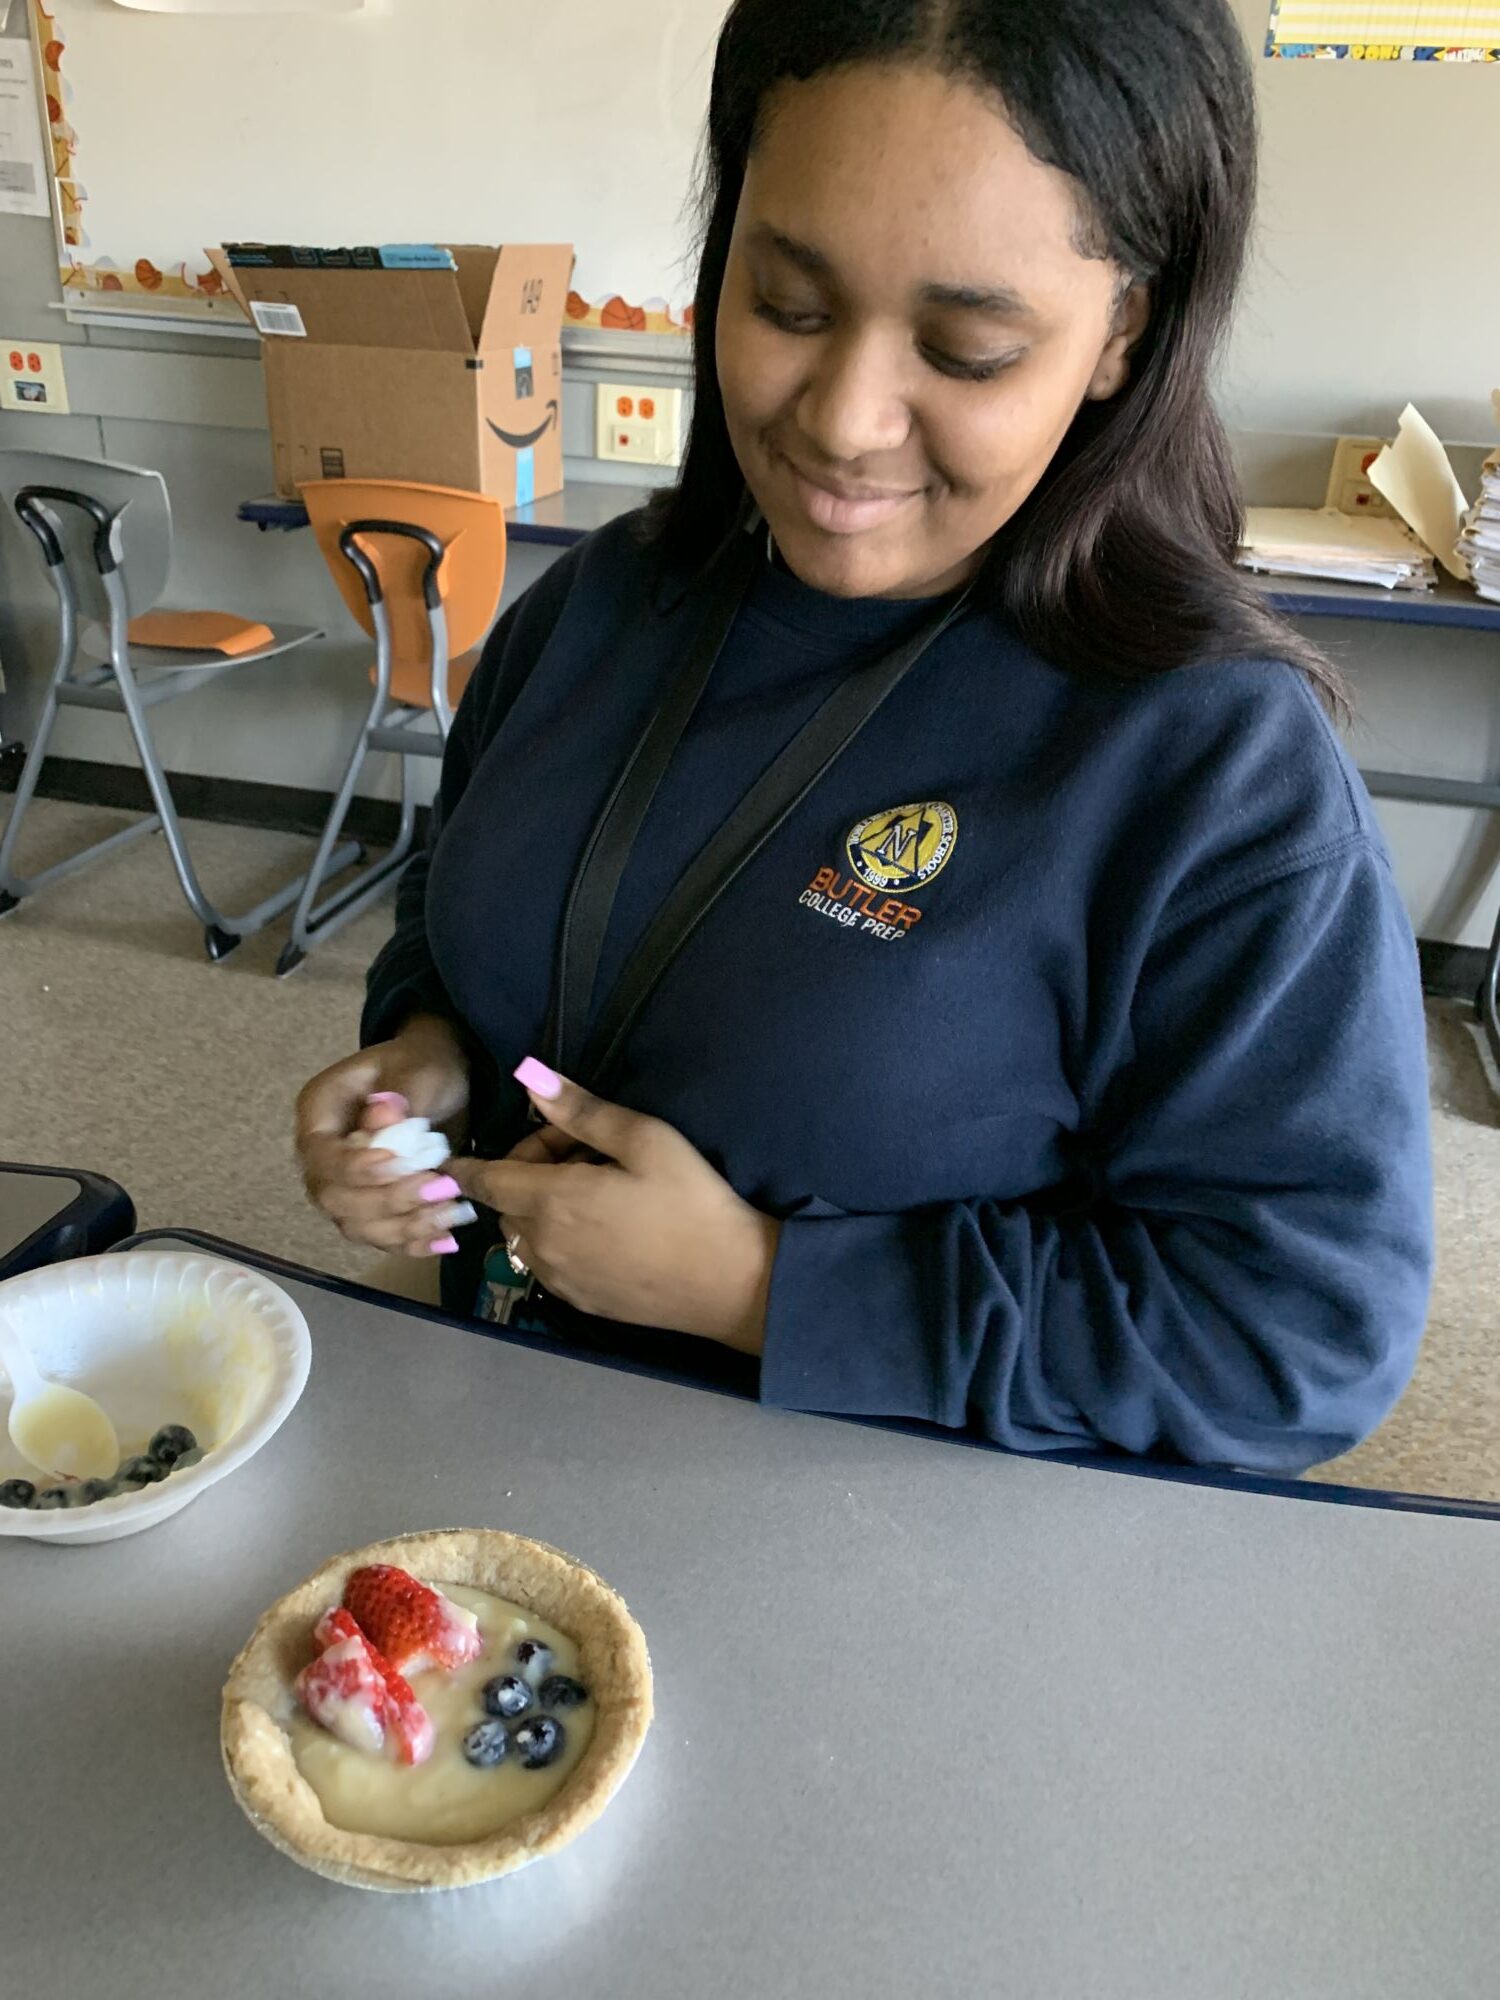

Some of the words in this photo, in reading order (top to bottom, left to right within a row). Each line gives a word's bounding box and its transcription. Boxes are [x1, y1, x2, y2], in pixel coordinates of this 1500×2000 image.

[877, 823, 917, 860] N
[917, 834, 952, 880] SCHOOLS
[809, 866, 922, 929] BUTLER
[863, 867, 889, 887] 1999
[798, 889, 862, 927] COLLEGE
[860, 917, 906, 941] PREP
